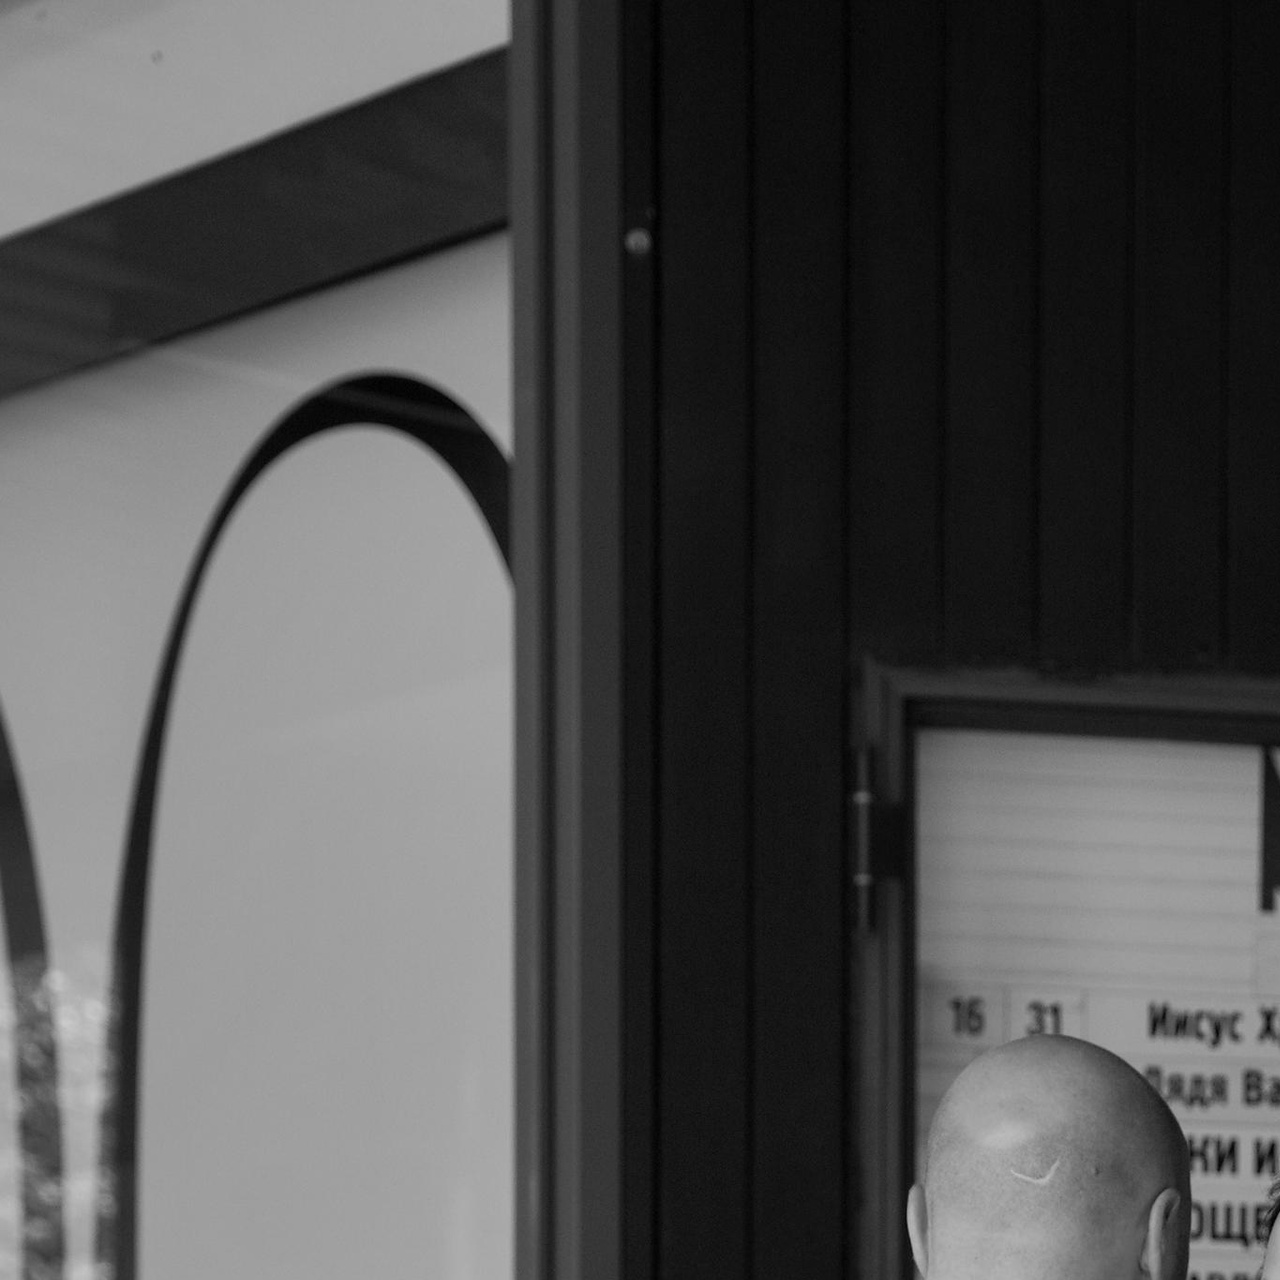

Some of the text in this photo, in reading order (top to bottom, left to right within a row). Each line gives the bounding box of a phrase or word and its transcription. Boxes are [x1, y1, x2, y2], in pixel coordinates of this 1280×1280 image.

[952, 998, 985, 1036] 16
[1026, 1001, 1062, 1035] 31
[1148, 1001, 1242, 1048] Иисус
[1188, 1136, 1238, 1174] КИ
